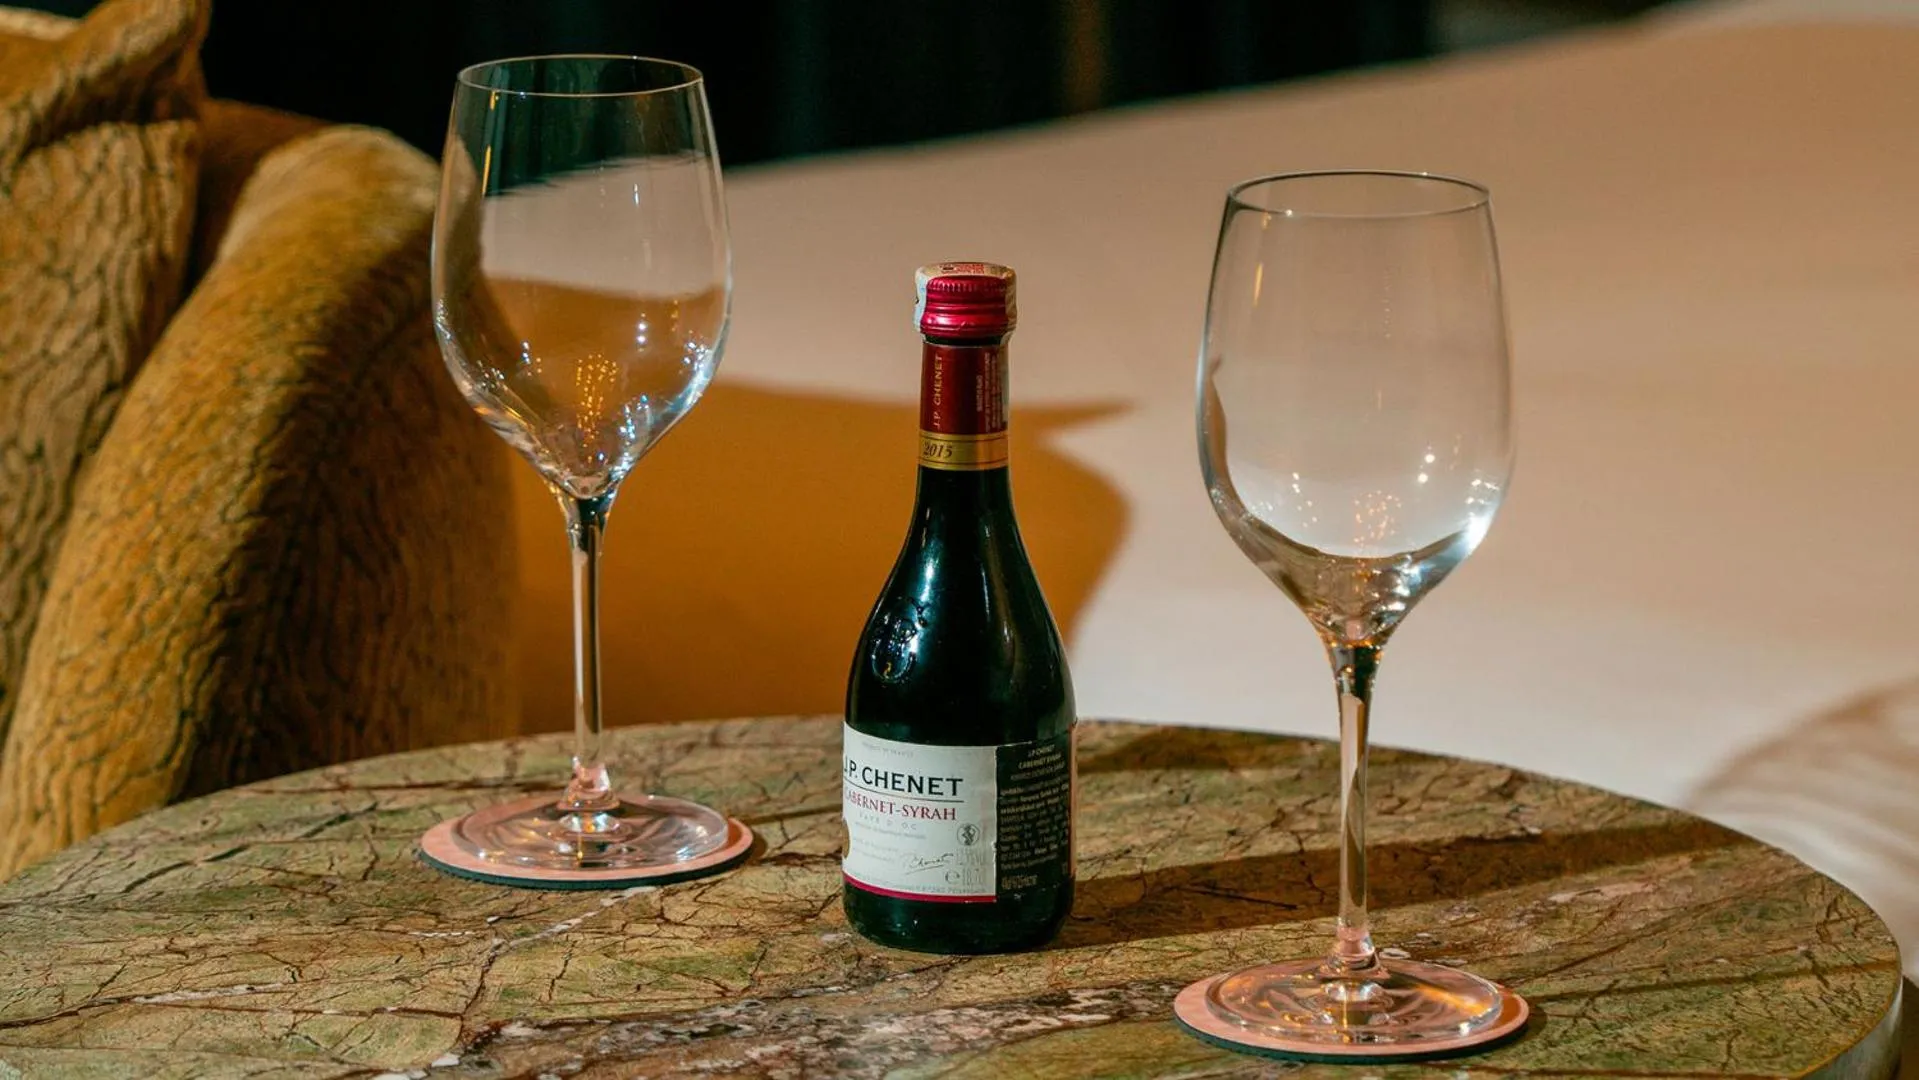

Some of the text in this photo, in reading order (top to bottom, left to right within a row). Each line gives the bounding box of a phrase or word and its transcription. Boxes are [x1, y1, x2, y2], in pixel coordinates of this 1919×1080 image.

[933, 353, 943, 406] CHENET
[923, 441, 953, 459] 2015
[862, 766, 963, 796] CHENET
